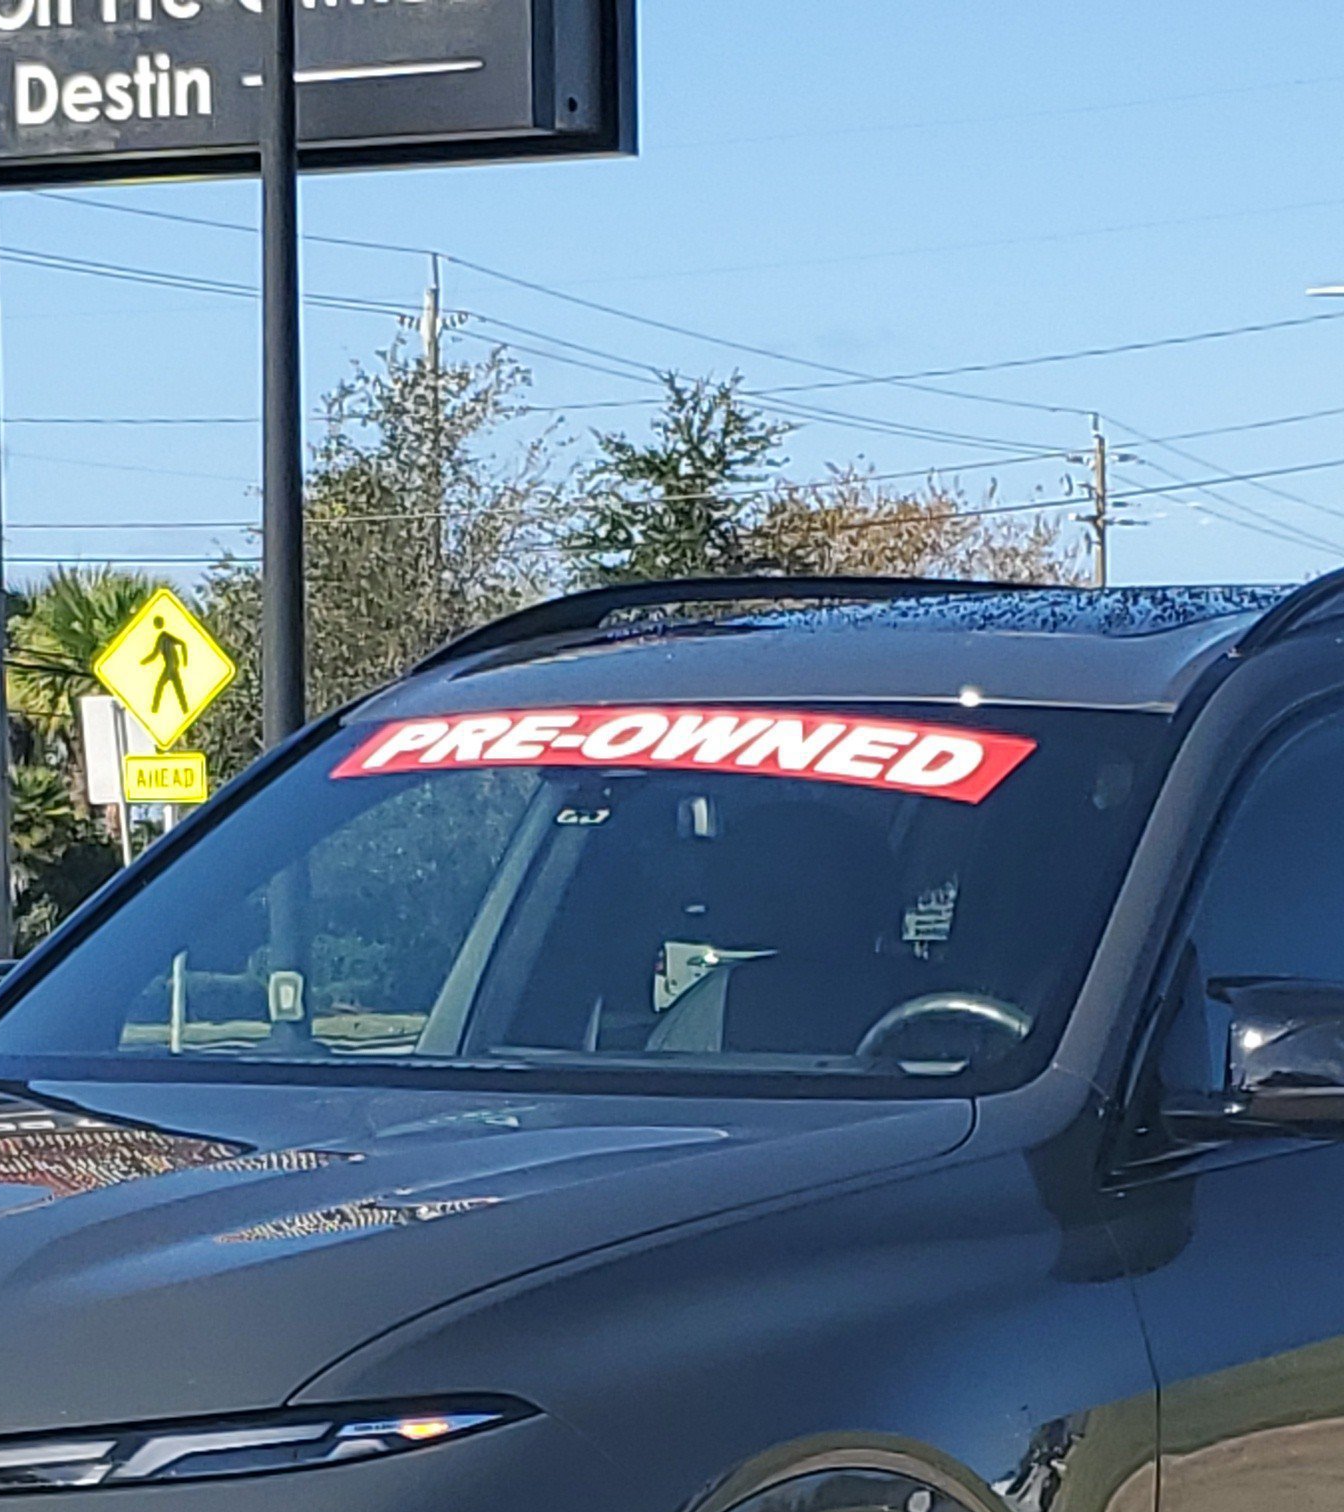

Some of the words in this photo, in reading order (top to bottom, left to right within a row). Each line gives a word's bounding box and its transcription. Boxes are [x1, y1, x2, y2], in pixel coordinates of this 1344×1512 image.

[14, 53, 212, 125] Destin
[136, 767, 195, 789] AHEAD
[361, 712, 985, 788] PRE-OWNED
